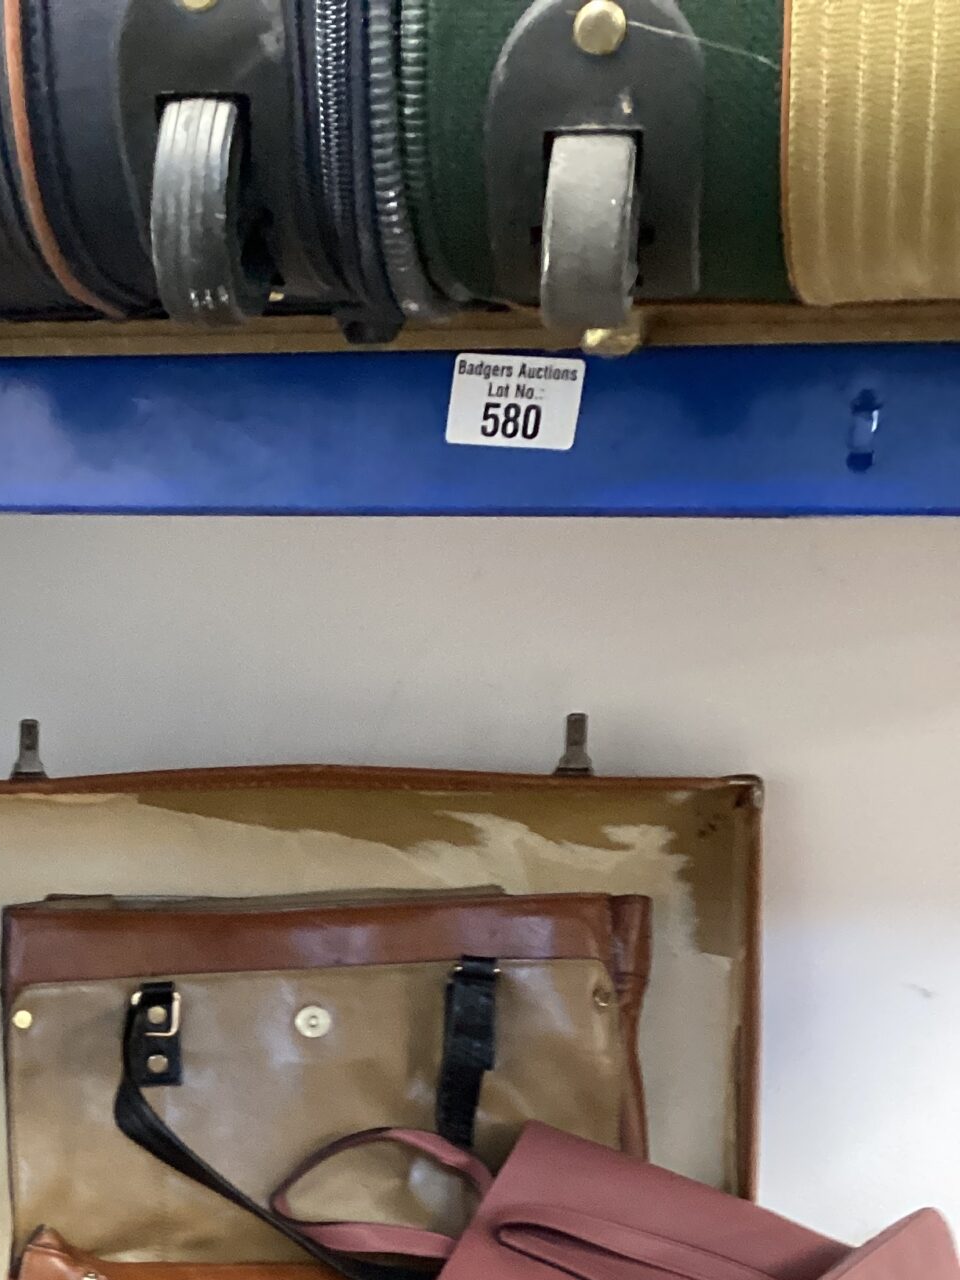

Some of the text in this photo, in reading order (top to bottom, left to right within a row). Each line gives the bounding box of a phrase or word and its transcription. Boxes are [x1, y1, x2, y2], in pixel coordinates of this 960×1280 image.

[458, 360, 578, 381] Badgers Auctions
[487, 382, 510, 398] Lot
[481, 402, 542, 440] 580
